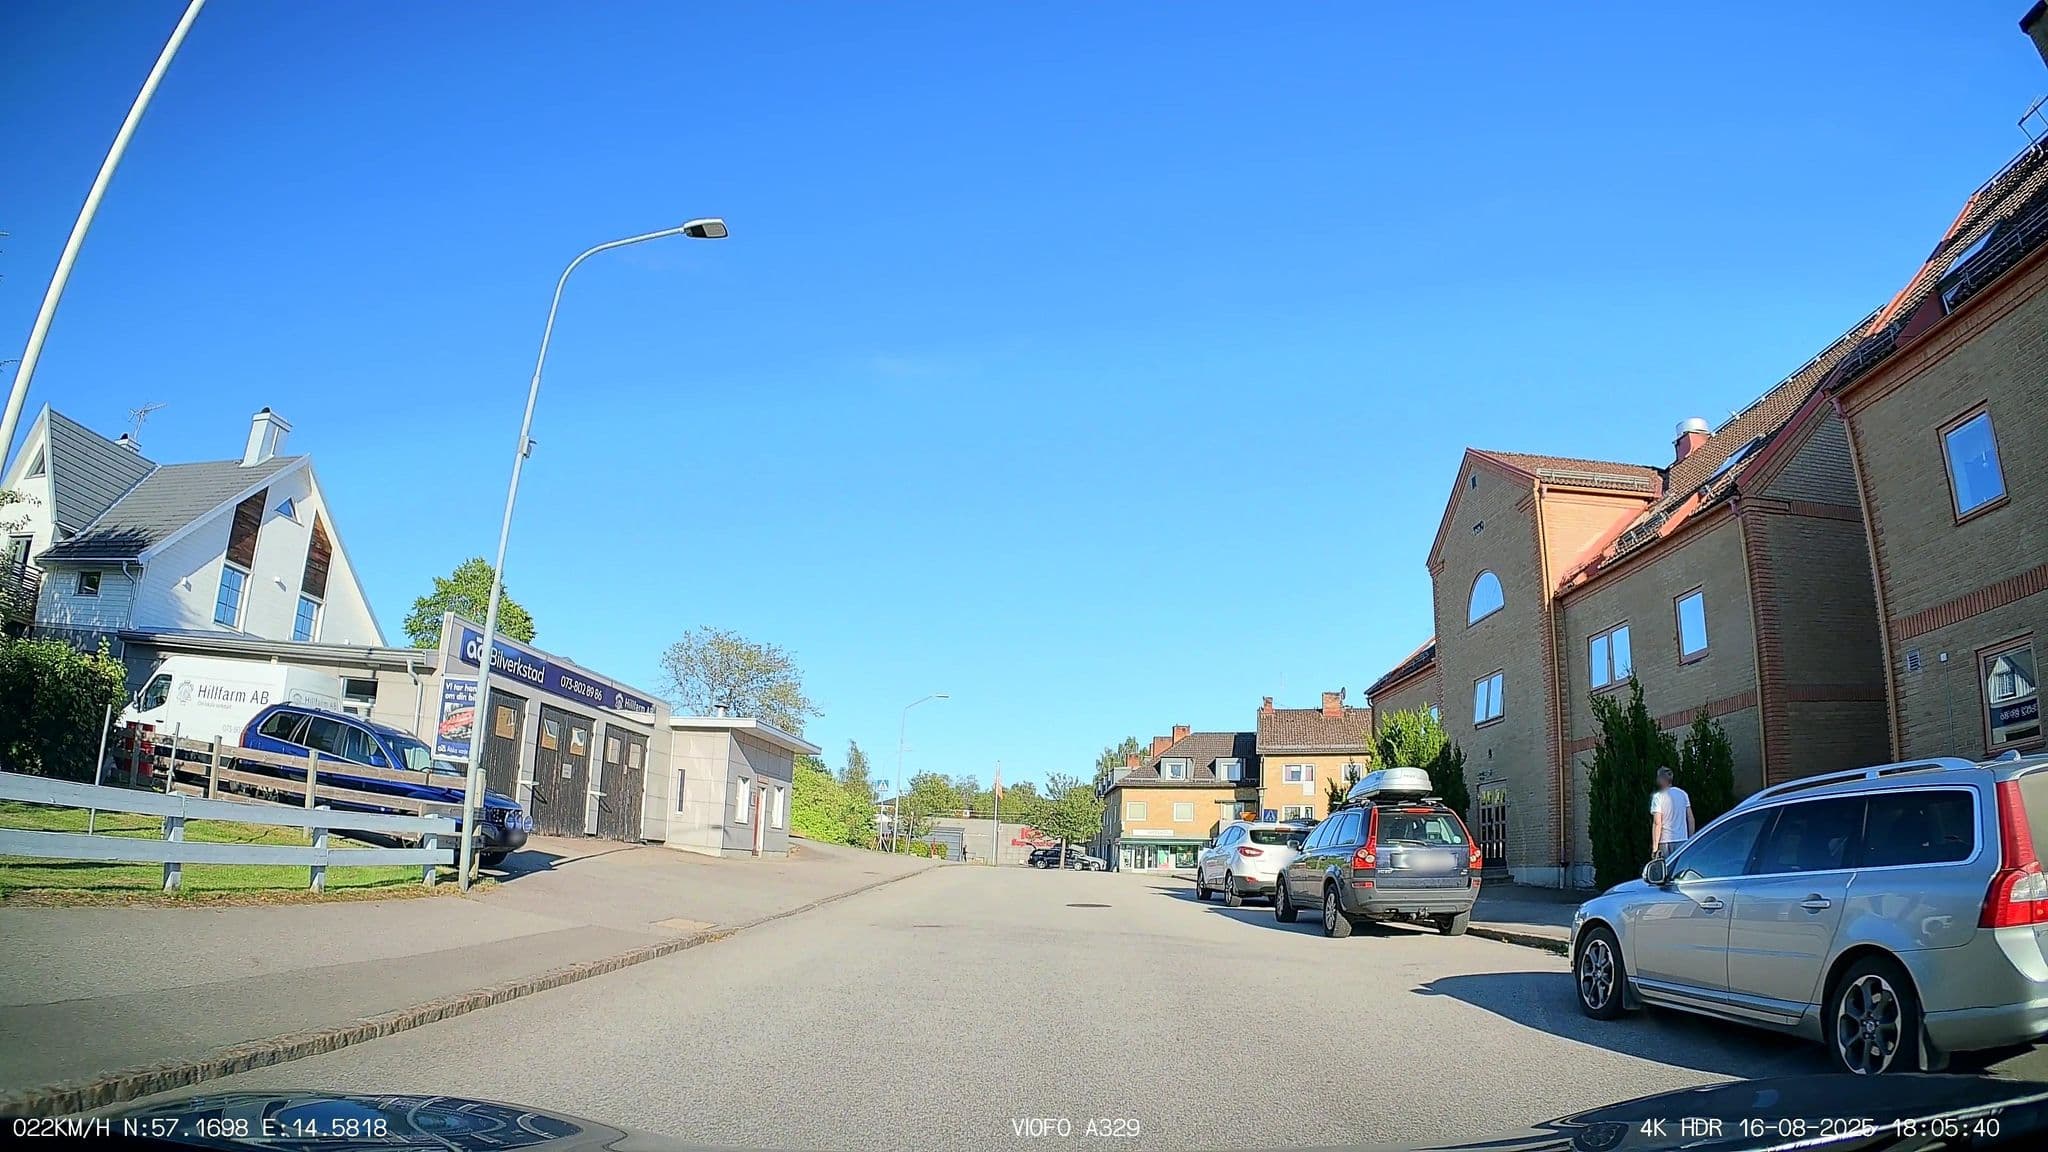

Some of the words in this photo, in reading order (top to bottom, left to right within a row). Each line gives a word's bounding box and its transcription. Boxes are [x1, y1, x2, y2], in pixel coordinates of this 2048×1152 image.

[489, 647, 545, 684] Bilverkstad
[197, 684, 246, 703] Hillfarm
[250, 690, 269, 705] AB
[464, 683, 477, 693] han
[468, 692, 476, 702] bi
[560, 675, 586, 697] 073-802
[586, 685, 595, 698] 89
[594, 688, 603, 701] 86
